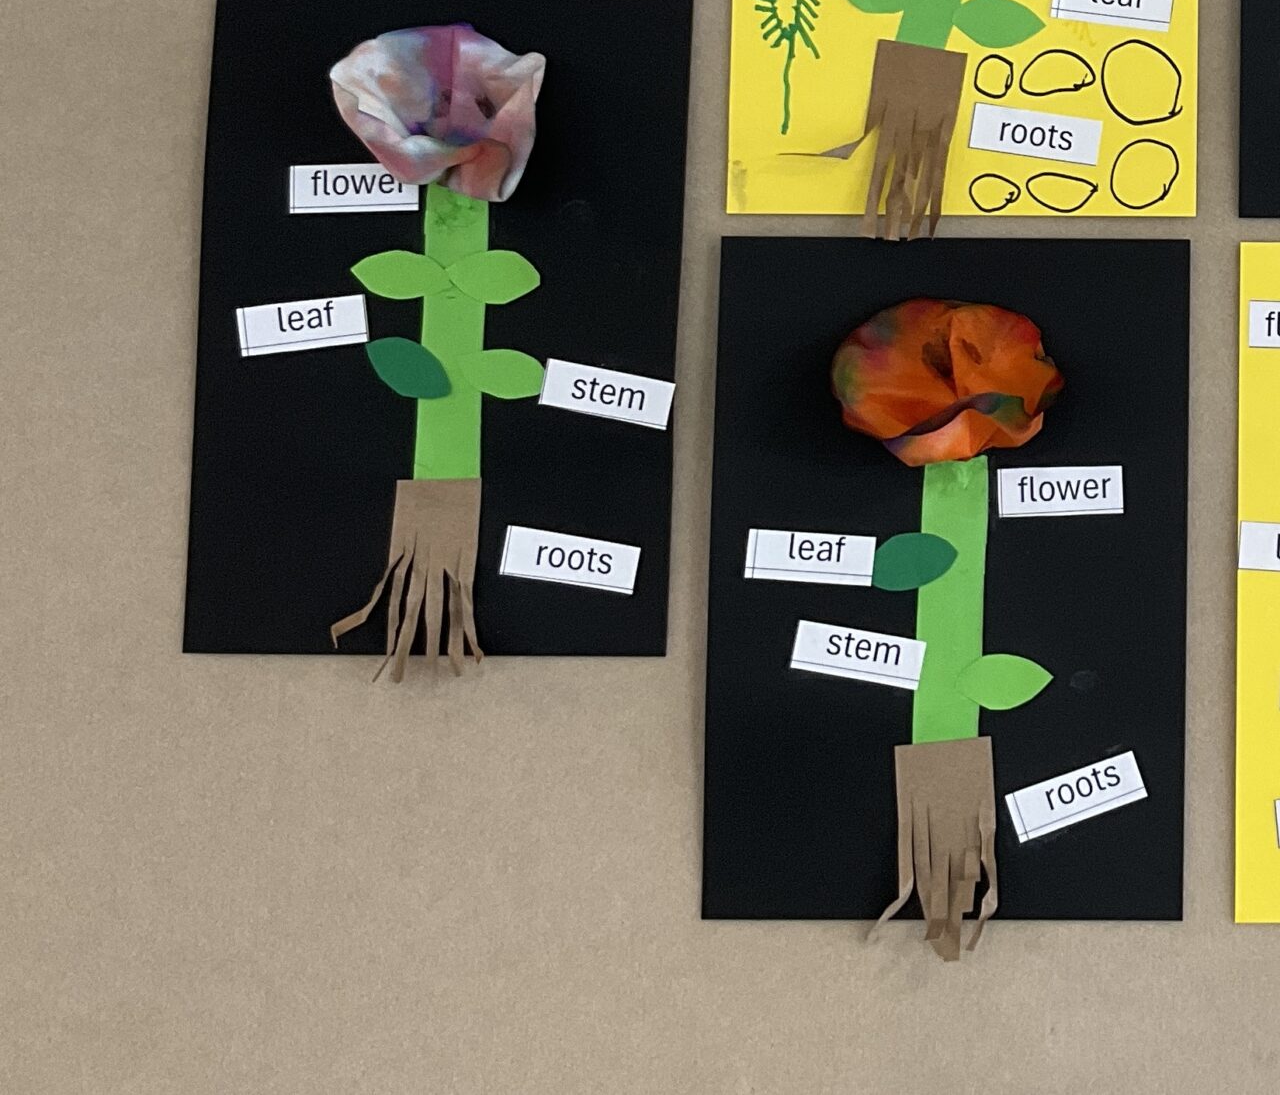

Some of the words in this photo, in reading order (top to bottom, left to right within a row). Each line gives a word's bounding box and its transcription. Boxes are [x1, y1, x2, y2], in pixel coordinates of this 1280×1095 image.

[999, 122, 1073, 150] roots
[277, 301, 335, 332] leaf
[571, 378, 646, 410] stem
[1018, 476, 1111, 502] flower
[536, 545, 613, 574] roots
[789, 534, 846, 562] leaf
[827, 633, 901, 665] stem
[1045, 765, 1121, 810] roots
